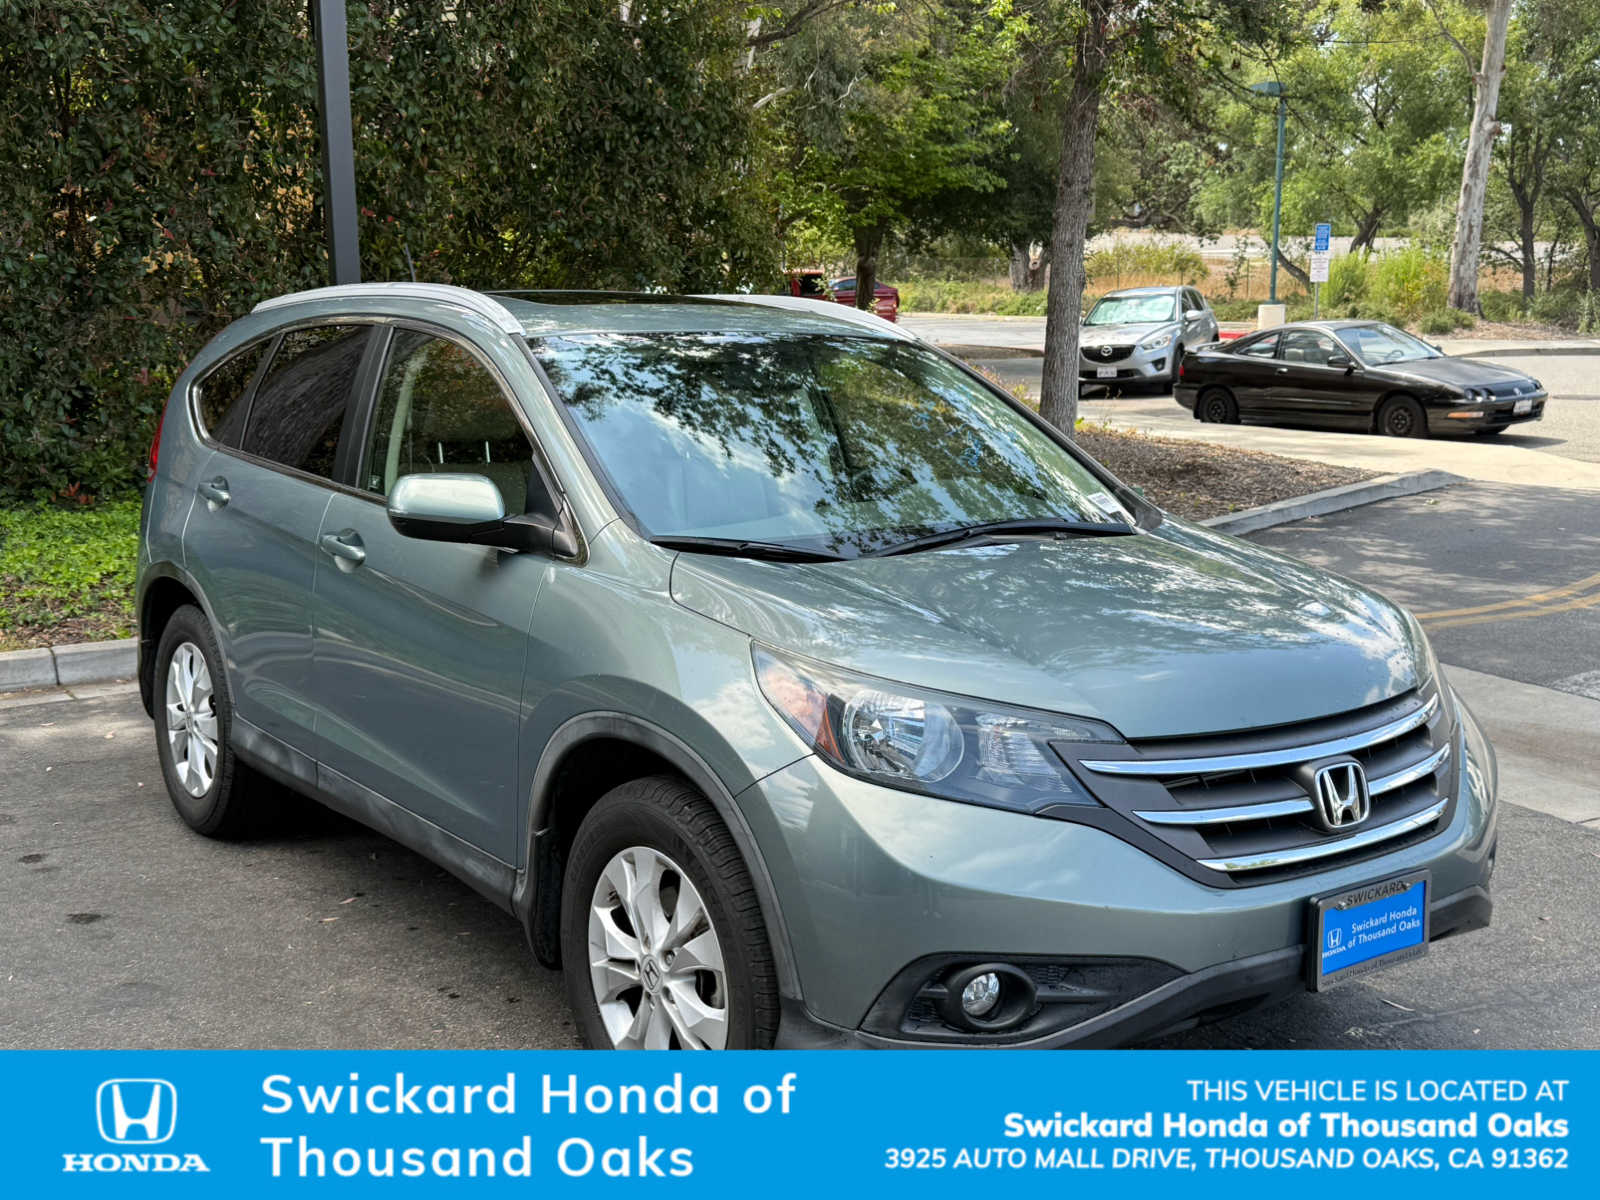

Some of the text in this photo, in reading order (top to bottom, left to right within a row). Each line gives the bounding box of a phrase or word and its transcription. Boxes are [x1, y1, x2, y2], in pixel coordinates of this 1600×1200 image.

[1347, 880, 1406, 905] SWICKARD
[1347, 918, 1421, 949] of Thousand Oaks
[1351, 905, 1417, 934] Swickard Honda
